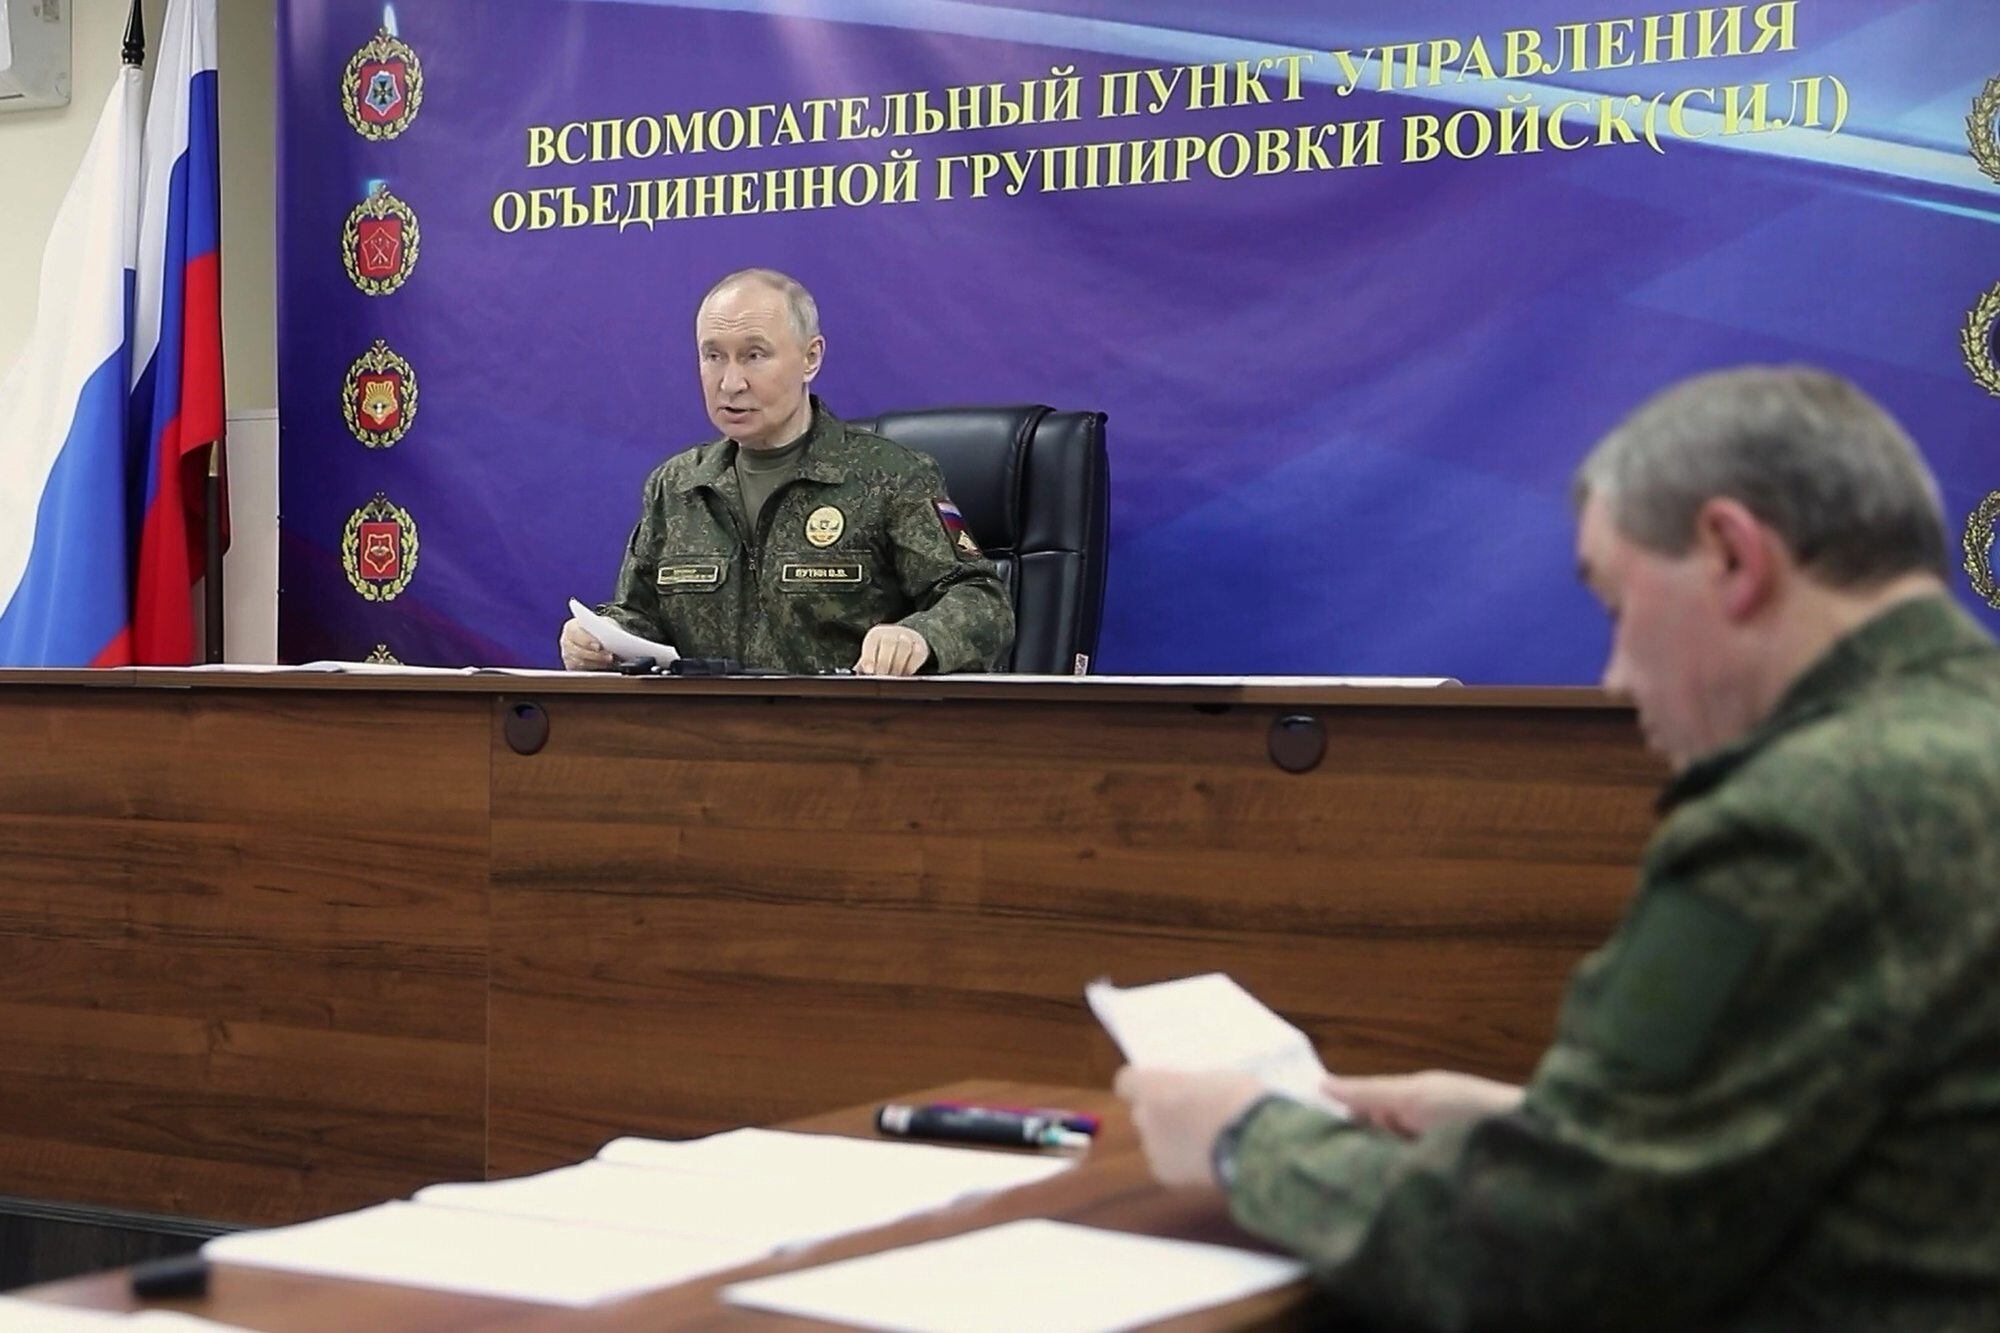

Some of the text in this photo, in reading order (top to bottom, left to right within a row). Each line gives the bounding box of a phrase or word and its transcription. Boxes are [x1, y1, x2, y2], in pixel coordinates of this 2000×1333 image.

[527, 0, 1798, 168] ВСПОМОГАТЕЛЬНЫЙ ПУНКТ УПРАВЛЕНИЯ
[492, 148, 920, 232] ОБЪЕДИНЕННОЙ
[936, 117, 1383, 201] ГРУППИРОВКИ
